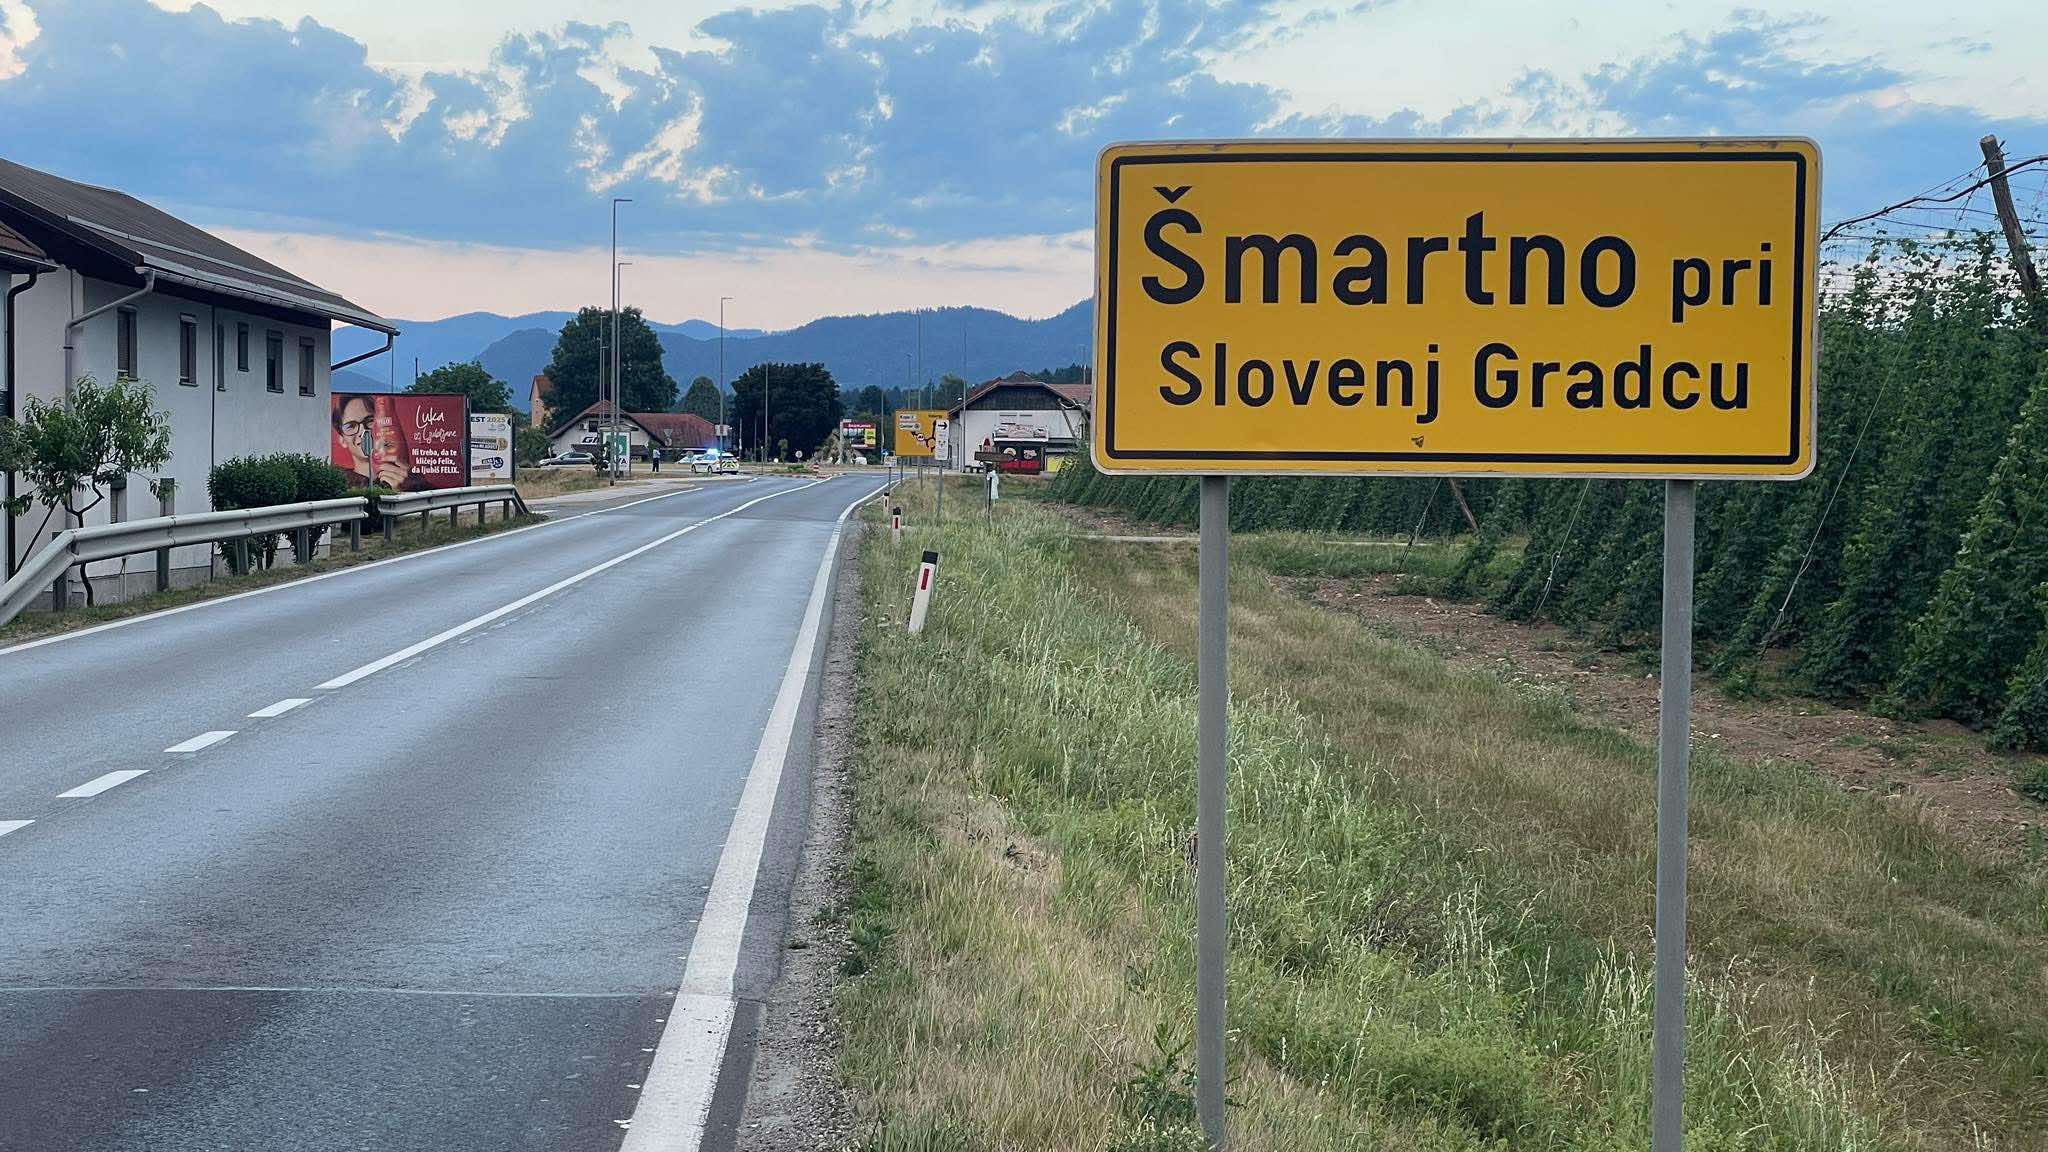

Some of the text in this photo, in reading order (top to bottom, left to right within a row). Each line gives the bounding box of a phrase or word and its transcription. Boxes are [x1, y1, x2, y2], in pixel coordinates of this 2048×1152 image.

[1142, 185, 1771, 323] Šmartno pri
[1160, 341, 1748, 424] Slovenj Gradcu
[416, 405, 445, 429] Luka
[412, 448, 457, 457] Ni treba, da te
[416, 457, 456, 466] kličejo Felix,
[411, 466, 420, 474] da
[421, 466, 440, 475] ljubiš
